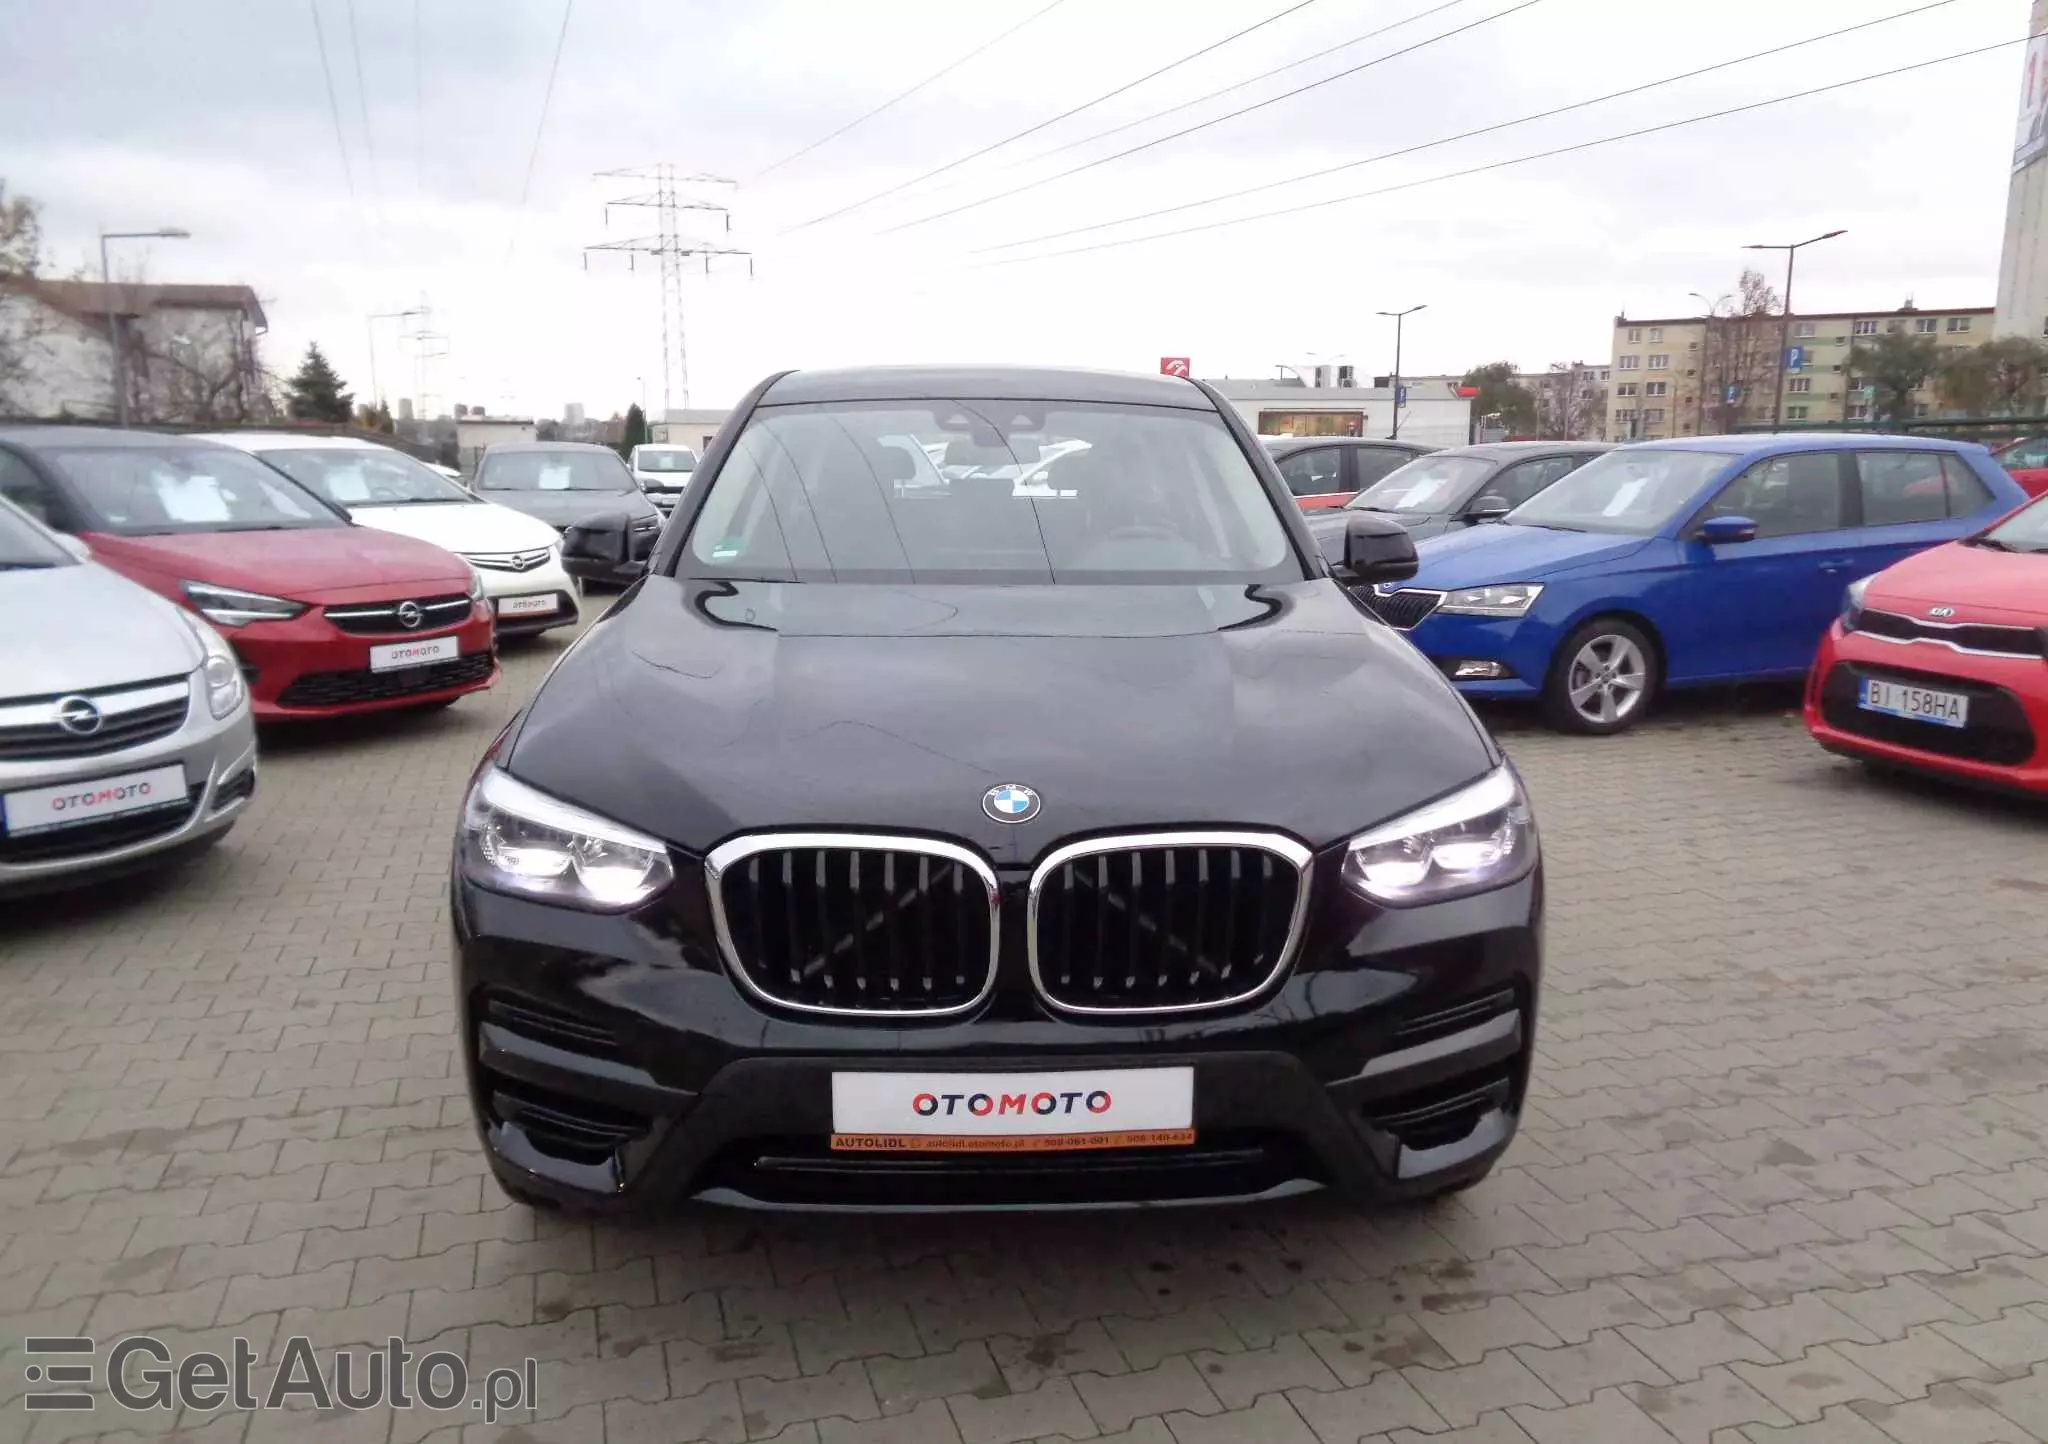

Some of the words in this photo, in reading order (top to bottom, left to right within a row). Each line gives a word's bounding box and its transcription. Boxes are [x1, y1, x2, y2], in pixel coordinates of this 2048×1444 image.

[391, 645, 440, 660] OTOMOTO
[1870, 682, 1890, 707] BI
[1902, 689, 1960, 719] 158HA
[52, 781, 151, 811] OTOMOTO
[912, 1090, 1112, 1116] OTOMOTO
[835, 1137, 906, 1149] AUTOLIDL
